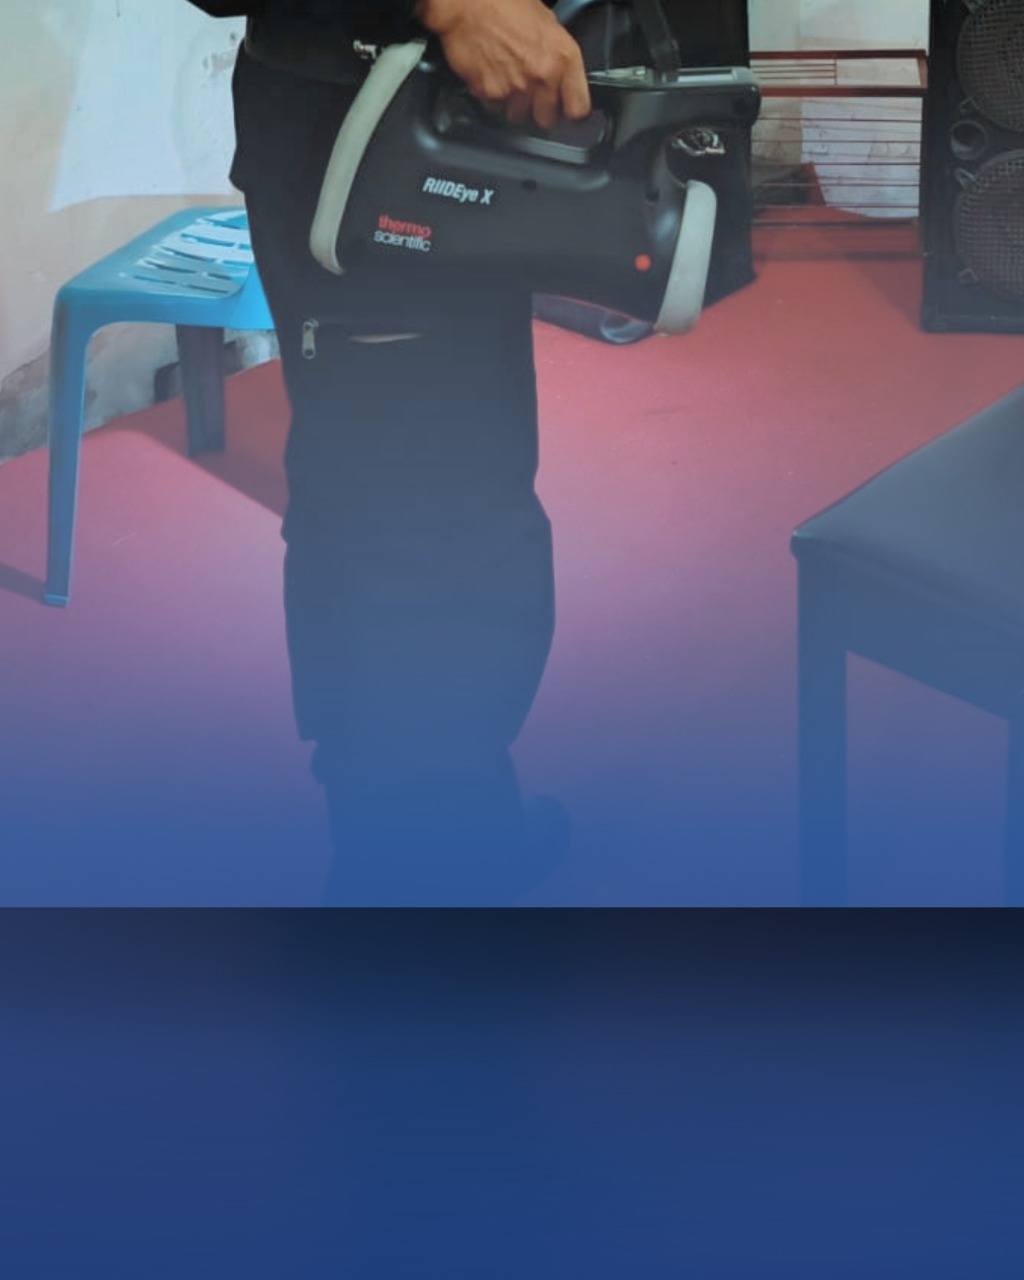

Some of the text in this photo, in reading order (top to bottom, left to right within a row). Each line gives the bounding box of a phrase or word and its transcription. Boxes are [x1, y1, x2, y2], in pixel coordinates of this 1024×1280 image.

[422, 176, 494, 205] RIIDEye X
[378, 214, 432, 238] thermo
[374, 230, 431, 252] scientific
